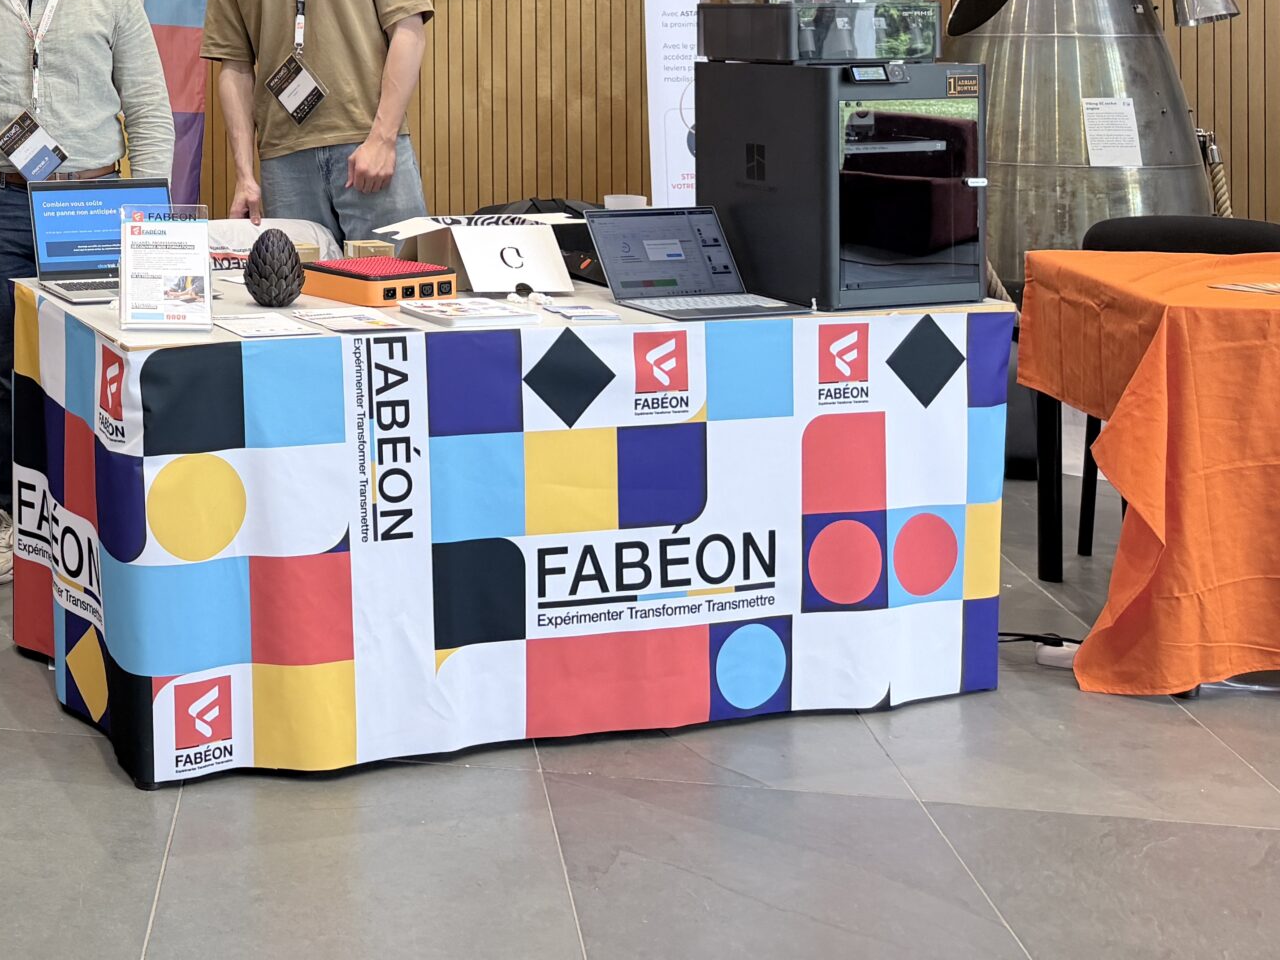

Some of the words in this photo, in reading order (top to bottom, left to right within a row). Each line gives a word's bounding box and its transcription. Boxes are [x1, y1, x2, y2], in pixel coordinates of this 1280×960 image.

[947, 77, 956, 94] 1
[56, 210, 75, 218] panne
[89, 208, 117, 217] anticipée
[353, 337, 364, 410] Expérimenter
[634, 393, 689, 411] FABÉON
[818, 384, 869, 401] FABÉON
[356, 410, 367, 476] Transformer
[373, 336, 421, 541] FABÉON
[359, 477, 369, 543] Transmettre
[537, 523, 776, 598] FABÉON
[537, 608, 624, 629] Expérimenter
[626, 603, 703, 620] Transformer
[705, 594, 775, 614] Transmettre
[175, 744, 233, 768] FABÉON
